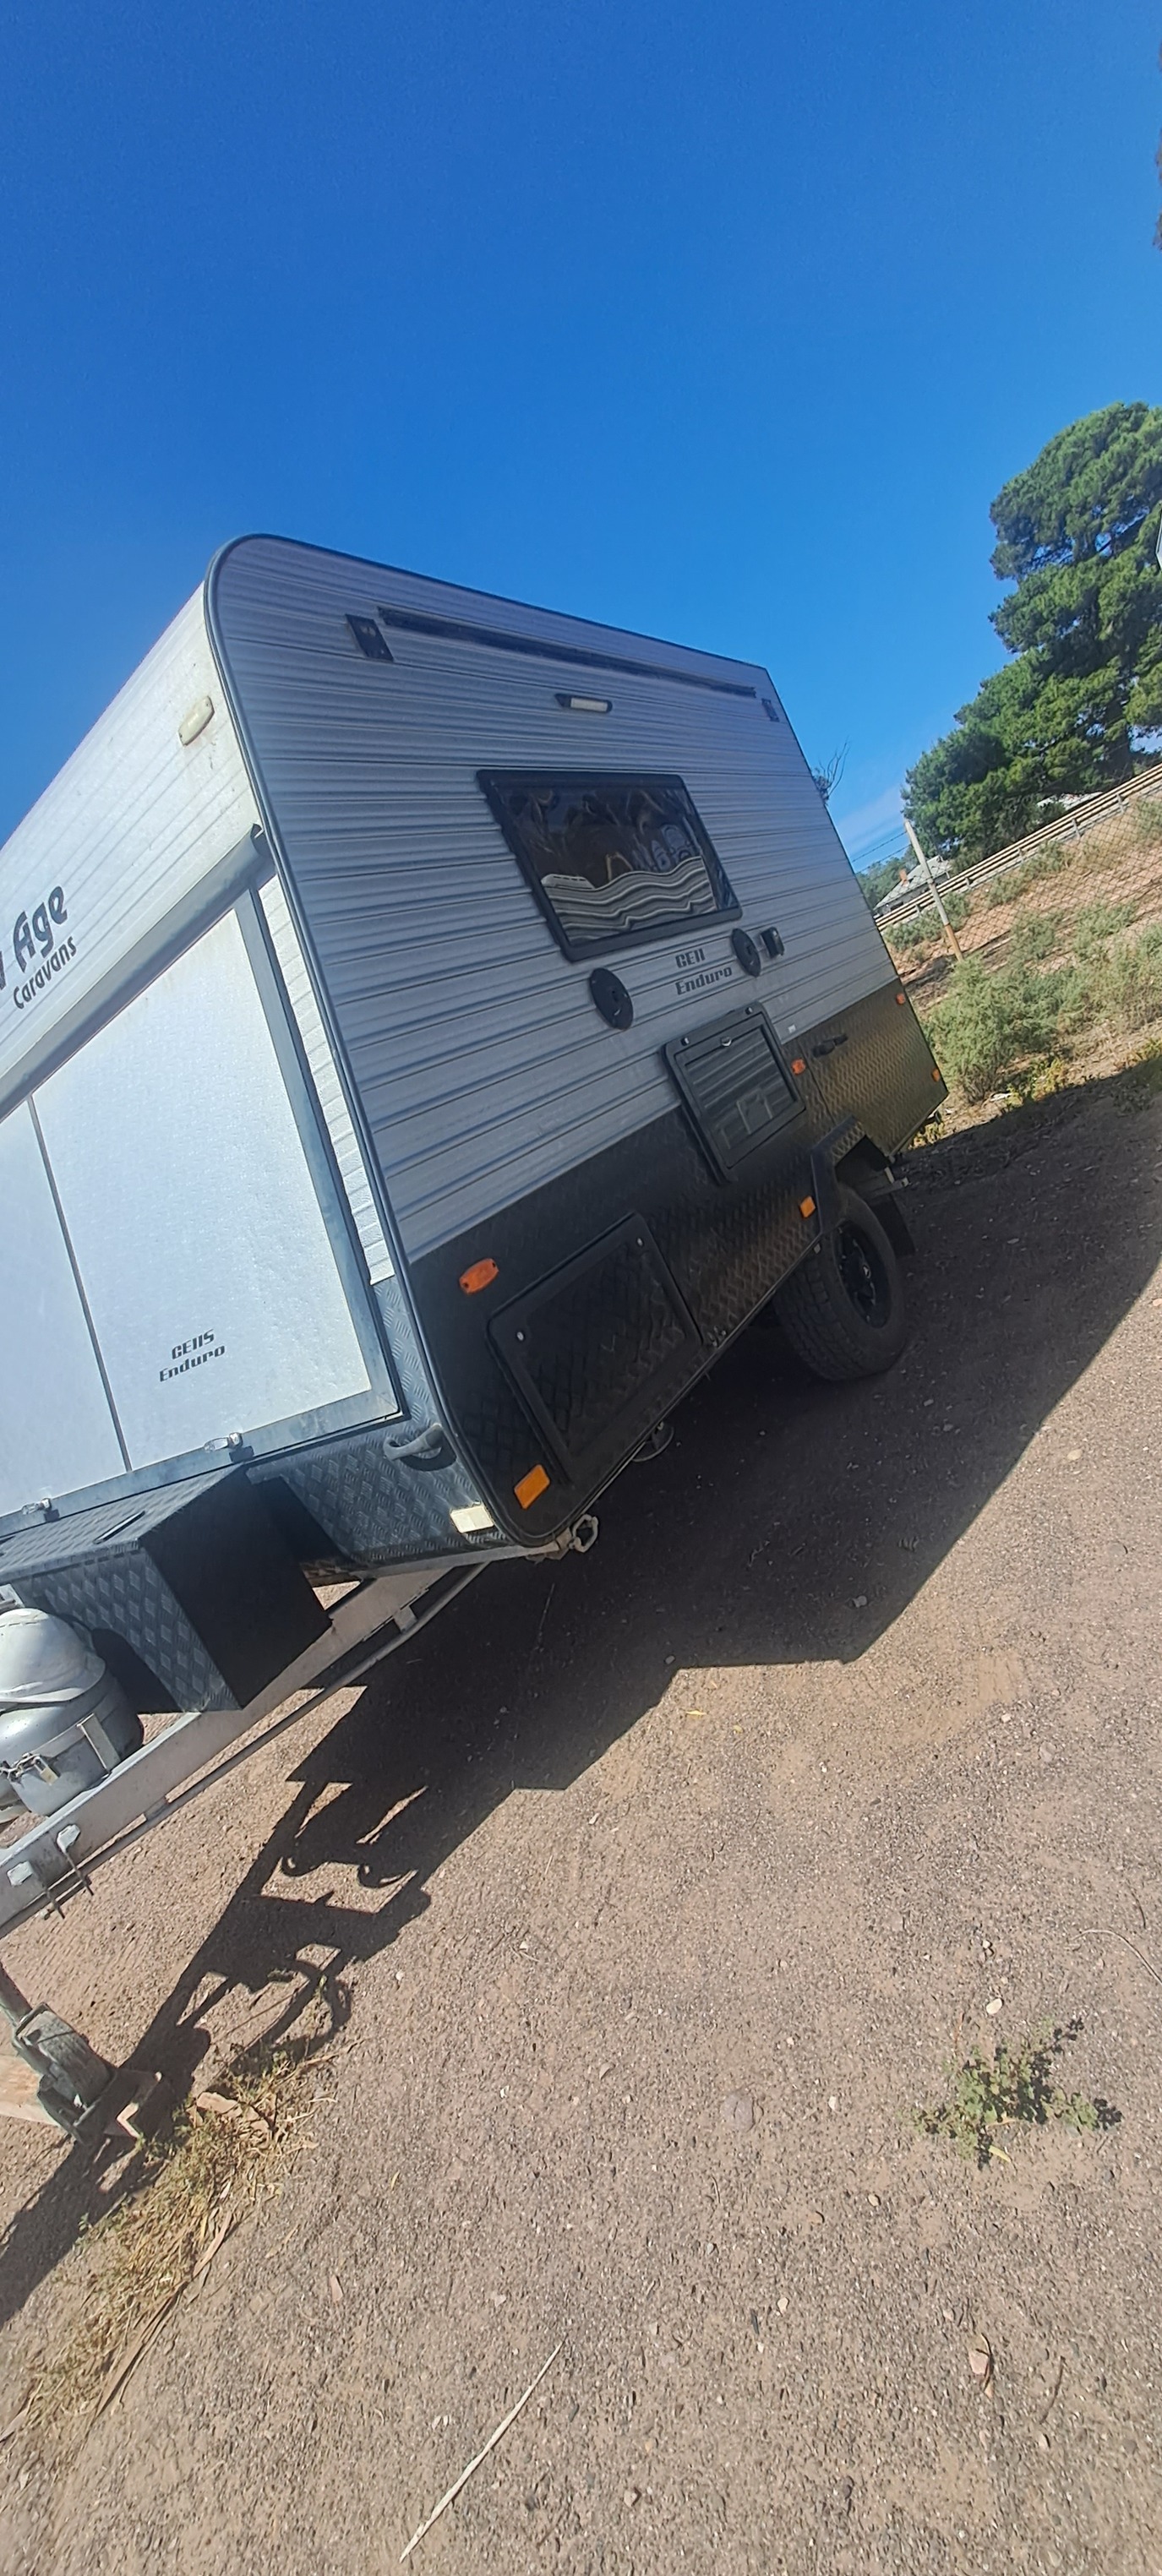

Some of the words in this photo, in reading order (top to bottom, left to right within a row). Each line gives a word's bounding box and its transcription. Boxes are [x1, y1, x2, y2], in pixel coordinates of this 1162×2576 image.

[14, 886, 68, 973] Age
[14, 936, 77, 1010] Caravans
[675, 967, 732, 995] Enduro
[159, 1345, 226, 1382] Enduro
